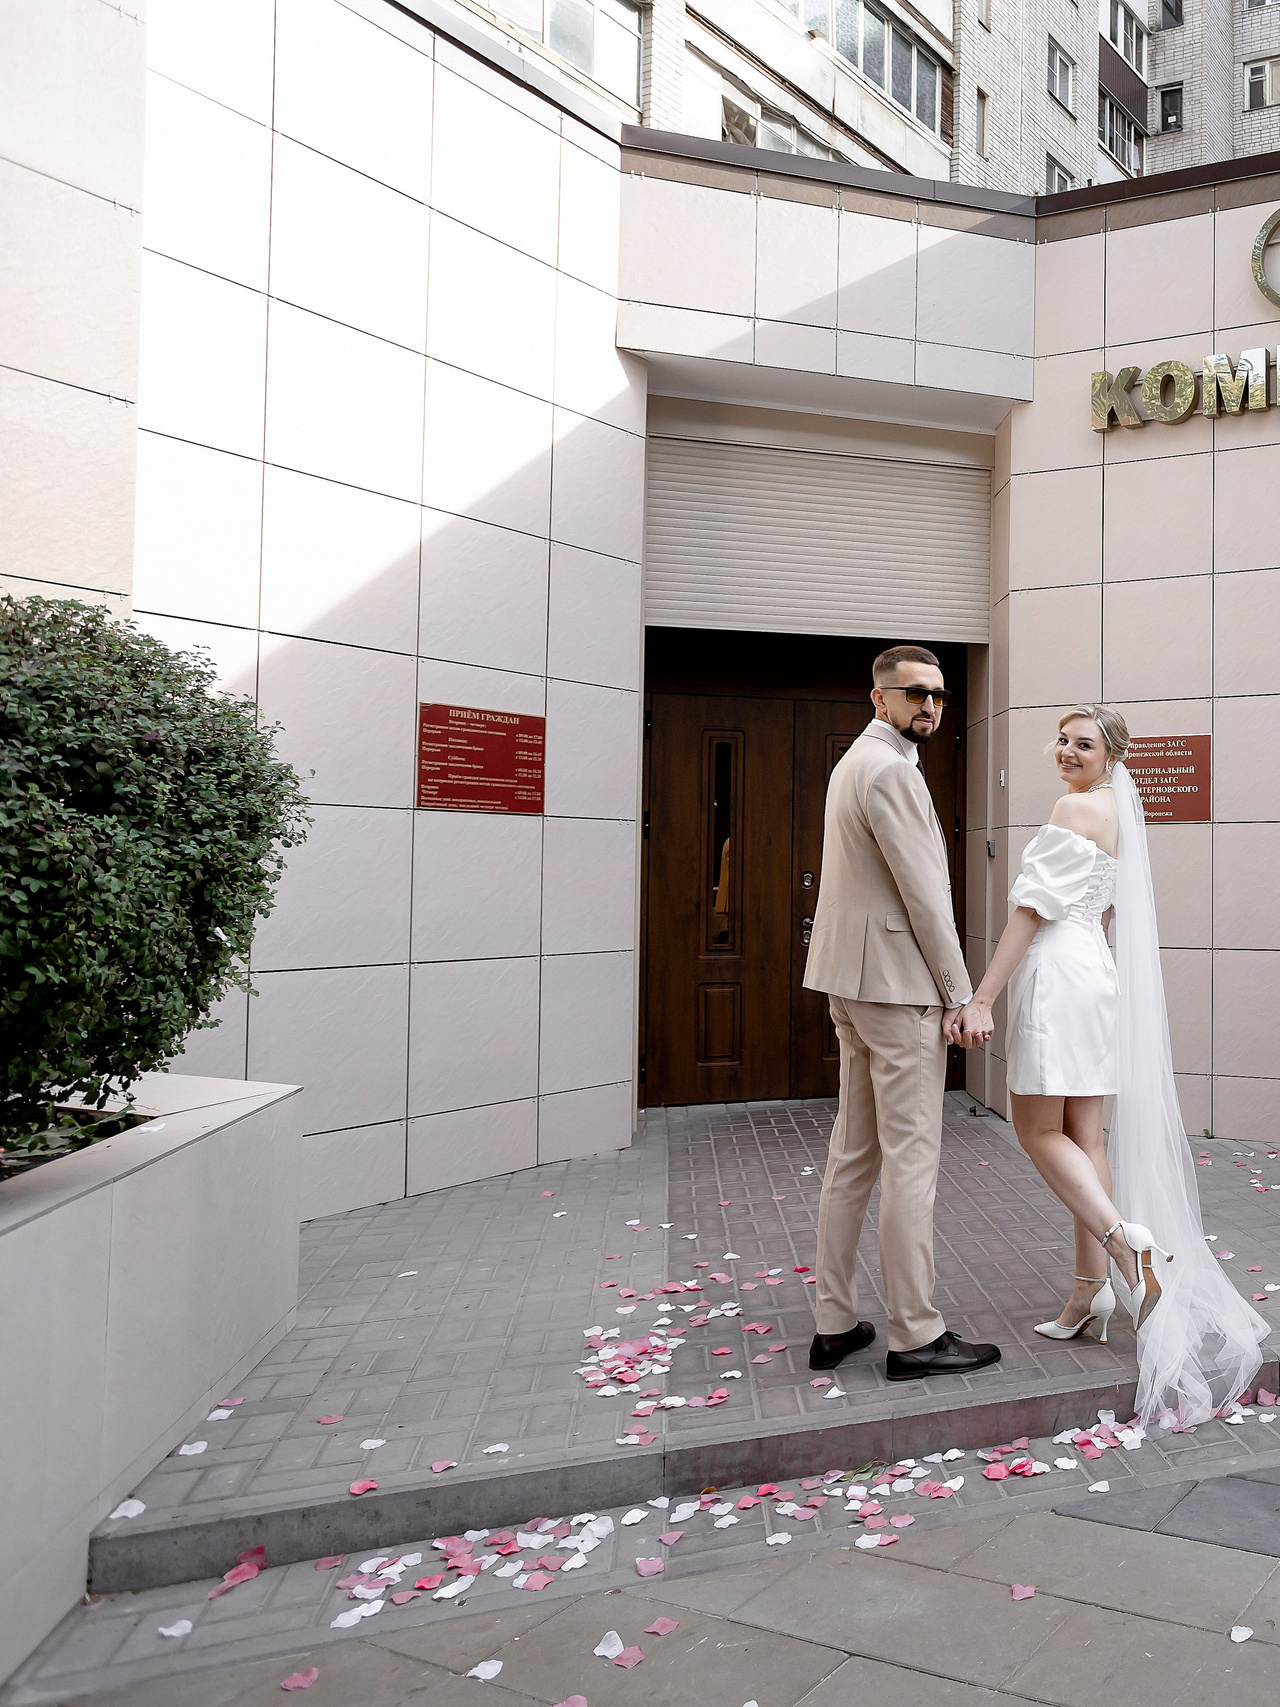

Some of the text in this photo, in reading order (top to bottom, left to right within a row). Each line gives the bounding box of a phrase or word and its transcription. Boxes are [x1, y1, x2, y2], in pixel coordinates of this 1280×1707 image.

[449, 709, 520, 725] ПРИЁМ ГРАЖДАН
[1128, 750, 1164, 759] ронежской
[1127, 765, 1195, 775] РРИТОРИАЛЬНЫЙ
[1133, 776, 1179, 785] ОТДЕЛ ЗАГС
[1137, 785, 1199, 794] НТЕРНОВСКОГО
[1140, 794, 1171, 803] РАЙОНА
